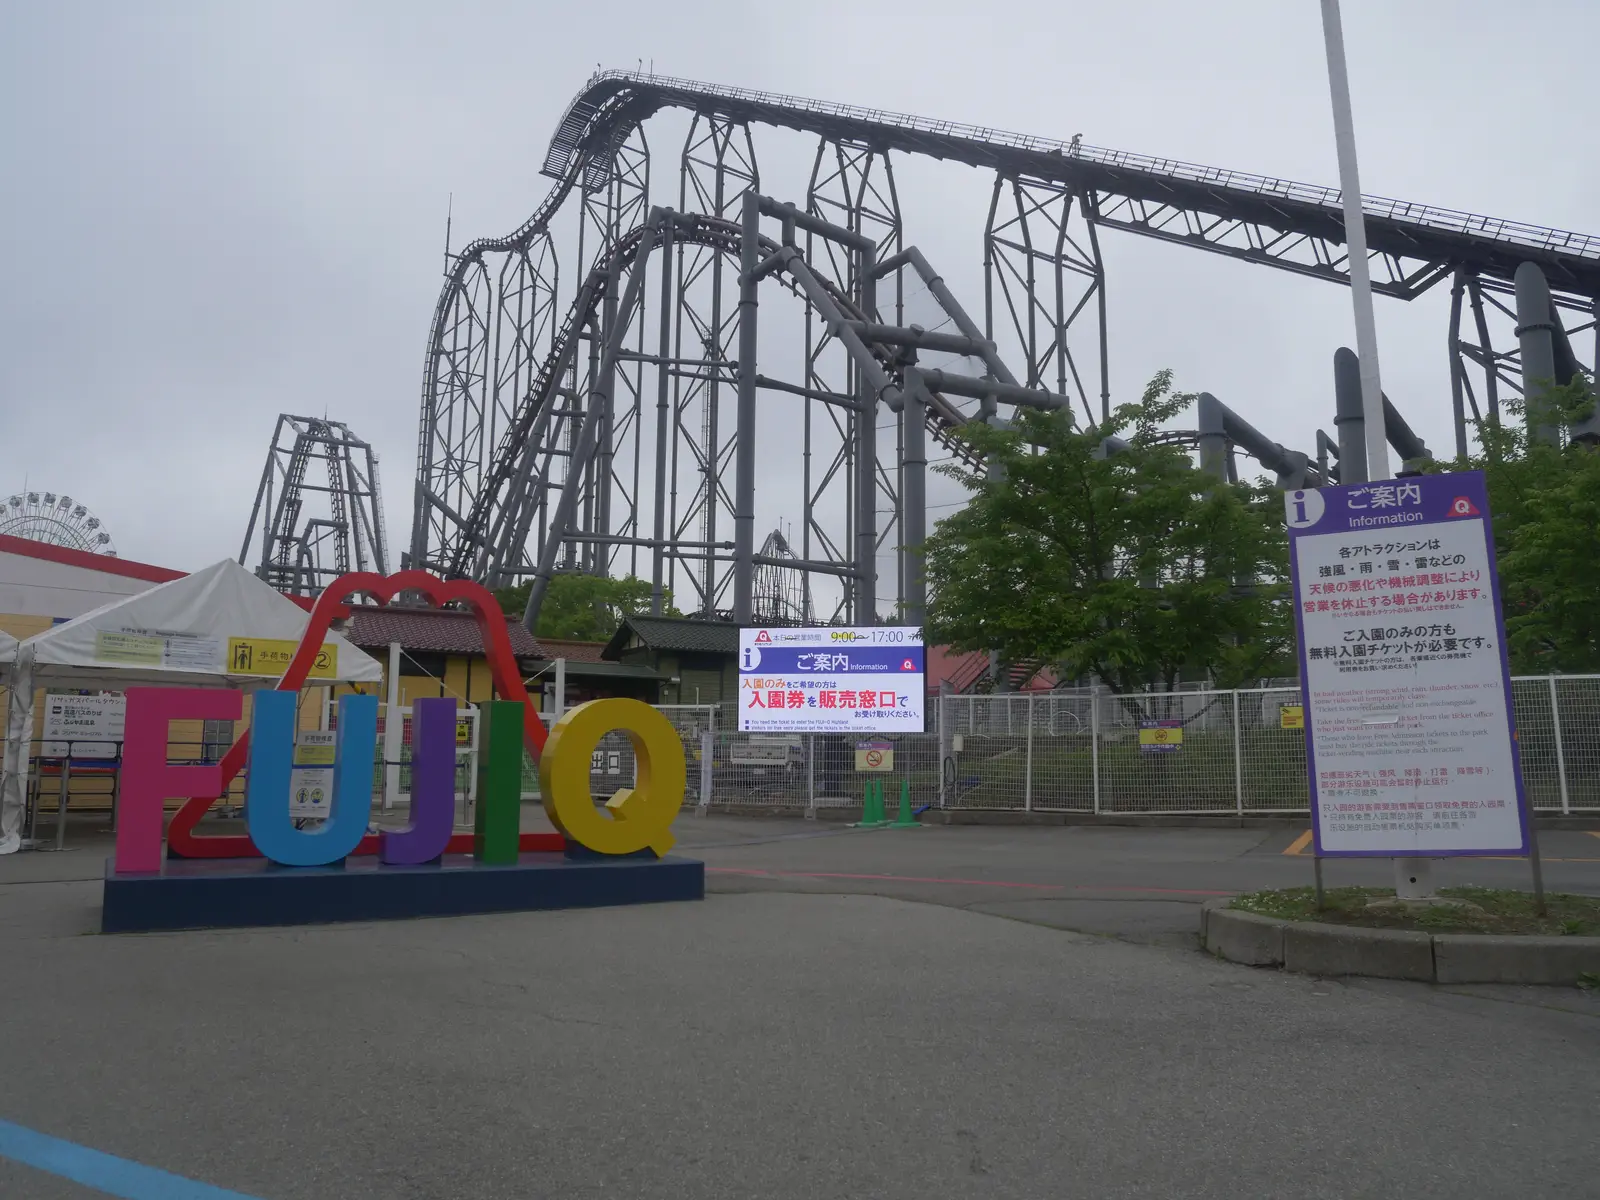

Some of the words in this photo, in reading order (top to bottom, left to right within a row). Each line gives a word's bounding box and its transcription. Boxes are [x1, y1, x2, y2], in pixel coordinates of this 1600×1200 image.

[1347, 483, 1421, 509] ご案内
[1349, 512, 1423, 527] Information
[1339, 538, 1441, 559] 各アトラクションは
[1309, 570, 1481, 596] 天候の悪化や機械調整により
[1303, 588, 1487, 613] 営業を休止する場合があります。
[871, 630, 904, 643] 17:00
[1343, 623, 1456, 642] ご入園のみの方も
[1309, 636, 1493, 660] 無料入園チケットが必要です。
[797, 652, 849, 671] ご案内
[742, 678, 837, 689] 入園のみをご希望の方は
[748, 690, 909, 709] 入園券を販売窓口で
[854, 710, 920, 719] お受け取りください。
[591, 753, 619, 770] 出口
